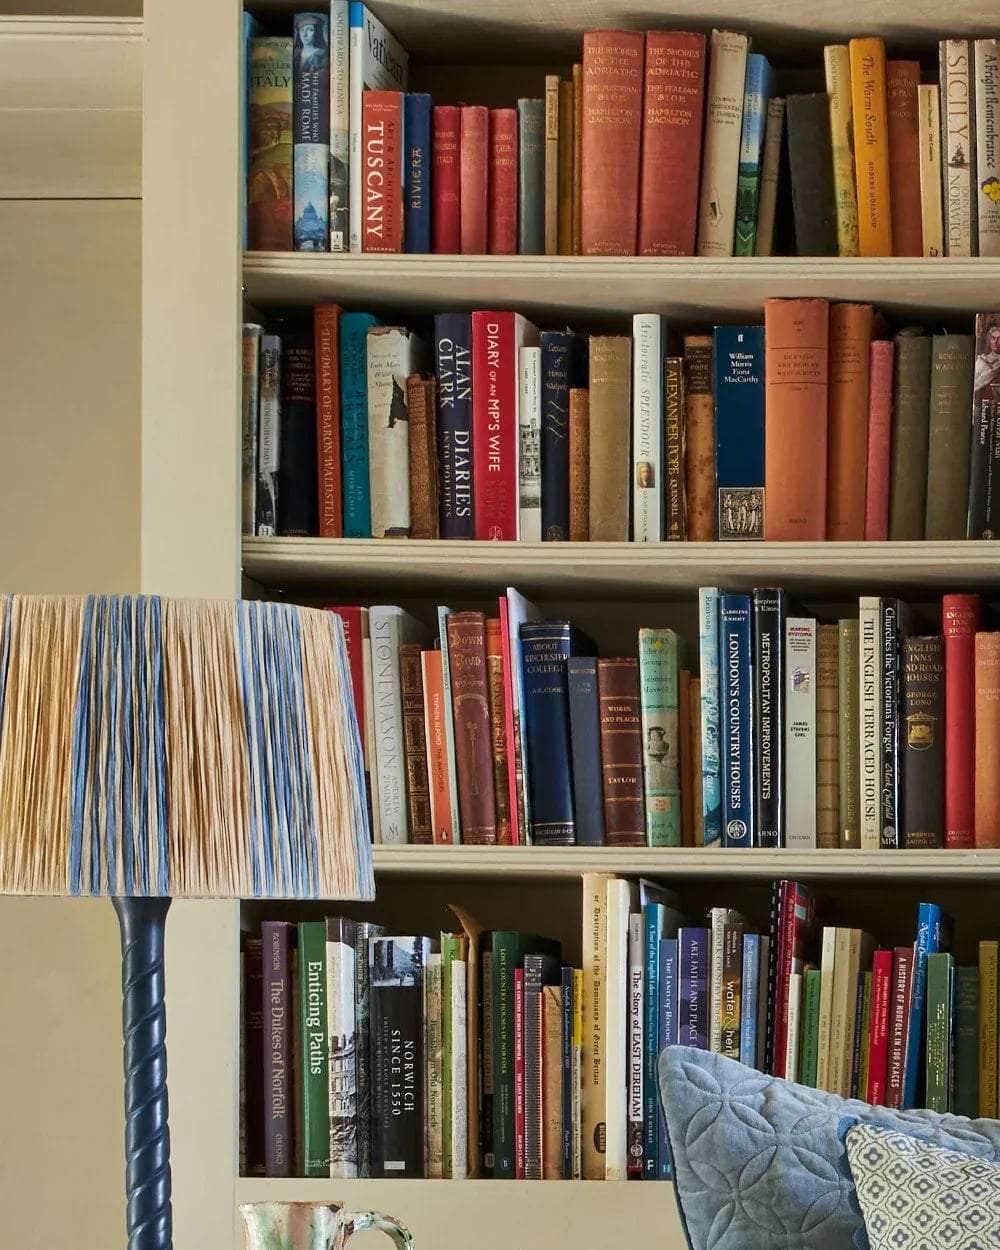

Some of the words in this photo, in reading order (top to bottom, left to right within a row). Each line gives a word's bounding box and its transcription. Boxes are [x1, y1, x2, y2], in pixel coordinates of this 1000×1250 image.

[648, 68, 699, 78] ADRIATIC
[862, 56, 874, 76] The
[985, 55, 997, 63] A
[252, 75, 290, 88] ITALY
[301, 72, 311, 103] MADE
[864, 80, 875, 110] Warm
[980, 65, 997, 94] Bright
[948, 55, 968, 140] SICILY
[301, 109, 311, 141] ROME
[865, 113, 877, 145] South
[985, 96, 998, 169] Remembrance
[367, 121, 384, 239] TUSCANY
[412, 148, 421, 208] RIVIERA
[949, 175, 961, 248] NORWICH
[321, 329, 330, 351] THE
[488, 323, 499, 368] DIARY
[321, 355, 330, 391] DIARY
[439, 338, 453, 408] CLARK
[456, 345, 471, 400] ALAN
[489, 371, 496, 379] OF
[489, 381, 497, 395] AN
[724, 376, 758, 384] MacCarthy
[322, 395, 331, 409] OF
[488, 398, 500, 431] MP'S
[667, 370, 678, 439] ALEXANDER
[323, 413, 332, 452] BARON
[488, 437, 500, 471] WIFE
[667, 445, 679, 474] POPE
[455, 430, 471, 517] DIARIES
[324, 457, 335, 527] WALDSTEIN
[864, 619, 874, 644] THE
[884, 607, 894, 652] Churches
[729, 633, 740, 697] LONDON'S
[761, 633, 771, 713] METROPOLITAN
[864, 647, 874, 702] ENGLISH
[884, 654, 894, 668] the
[376, 621, 397, 769] STONEMASON
[884, 670, 894, 719] Victorians
[730, 698, 741, 759] COUNTRY
[864, 705, 875, 775] TERRACED
[883, 721, 894, 753] Forgot
[762, 716, 772, 799] IMPROVEMENTS
[731, 761, 741, 809] HOUSES
[865, 779, 876, 821] HOUSE
[633, 971, 642, 988] The
[689, 961, 698, 987] FAITH
[897, 965, 906, 992] HISTORY
[271, 979, 284, 1003] The
[306, 961, 323, 1027] Enticing
[631, 992, 641, 1016] Story
[689, 990, 698, 1011] AND
[726, 981, 735, 1015] water
[897, 994, 905, 1003] OF
[271, 1006, 284, 1050] Dukes
[632, 1020, 641, 1029] of
[689, 1014, 698, 1040] PLACE
[895, 1005, 905, 1036] NORFOLK
[272, 1052, 285, 1065] of
[310, 1032, 324, 1074] Paths
[391, 1029, 401, 1073] SINCE
[632, 1033, 641, 1060] EAST
[404, 1040, 414, 1111] NORWICH
[632, 1063, 641, 1117] DEREHAM
[891, 1062, 901, 1088] PLACES
[271, 1069, 285, 1119] Norfolk
[391, 1083, 401, 1116] 1550
